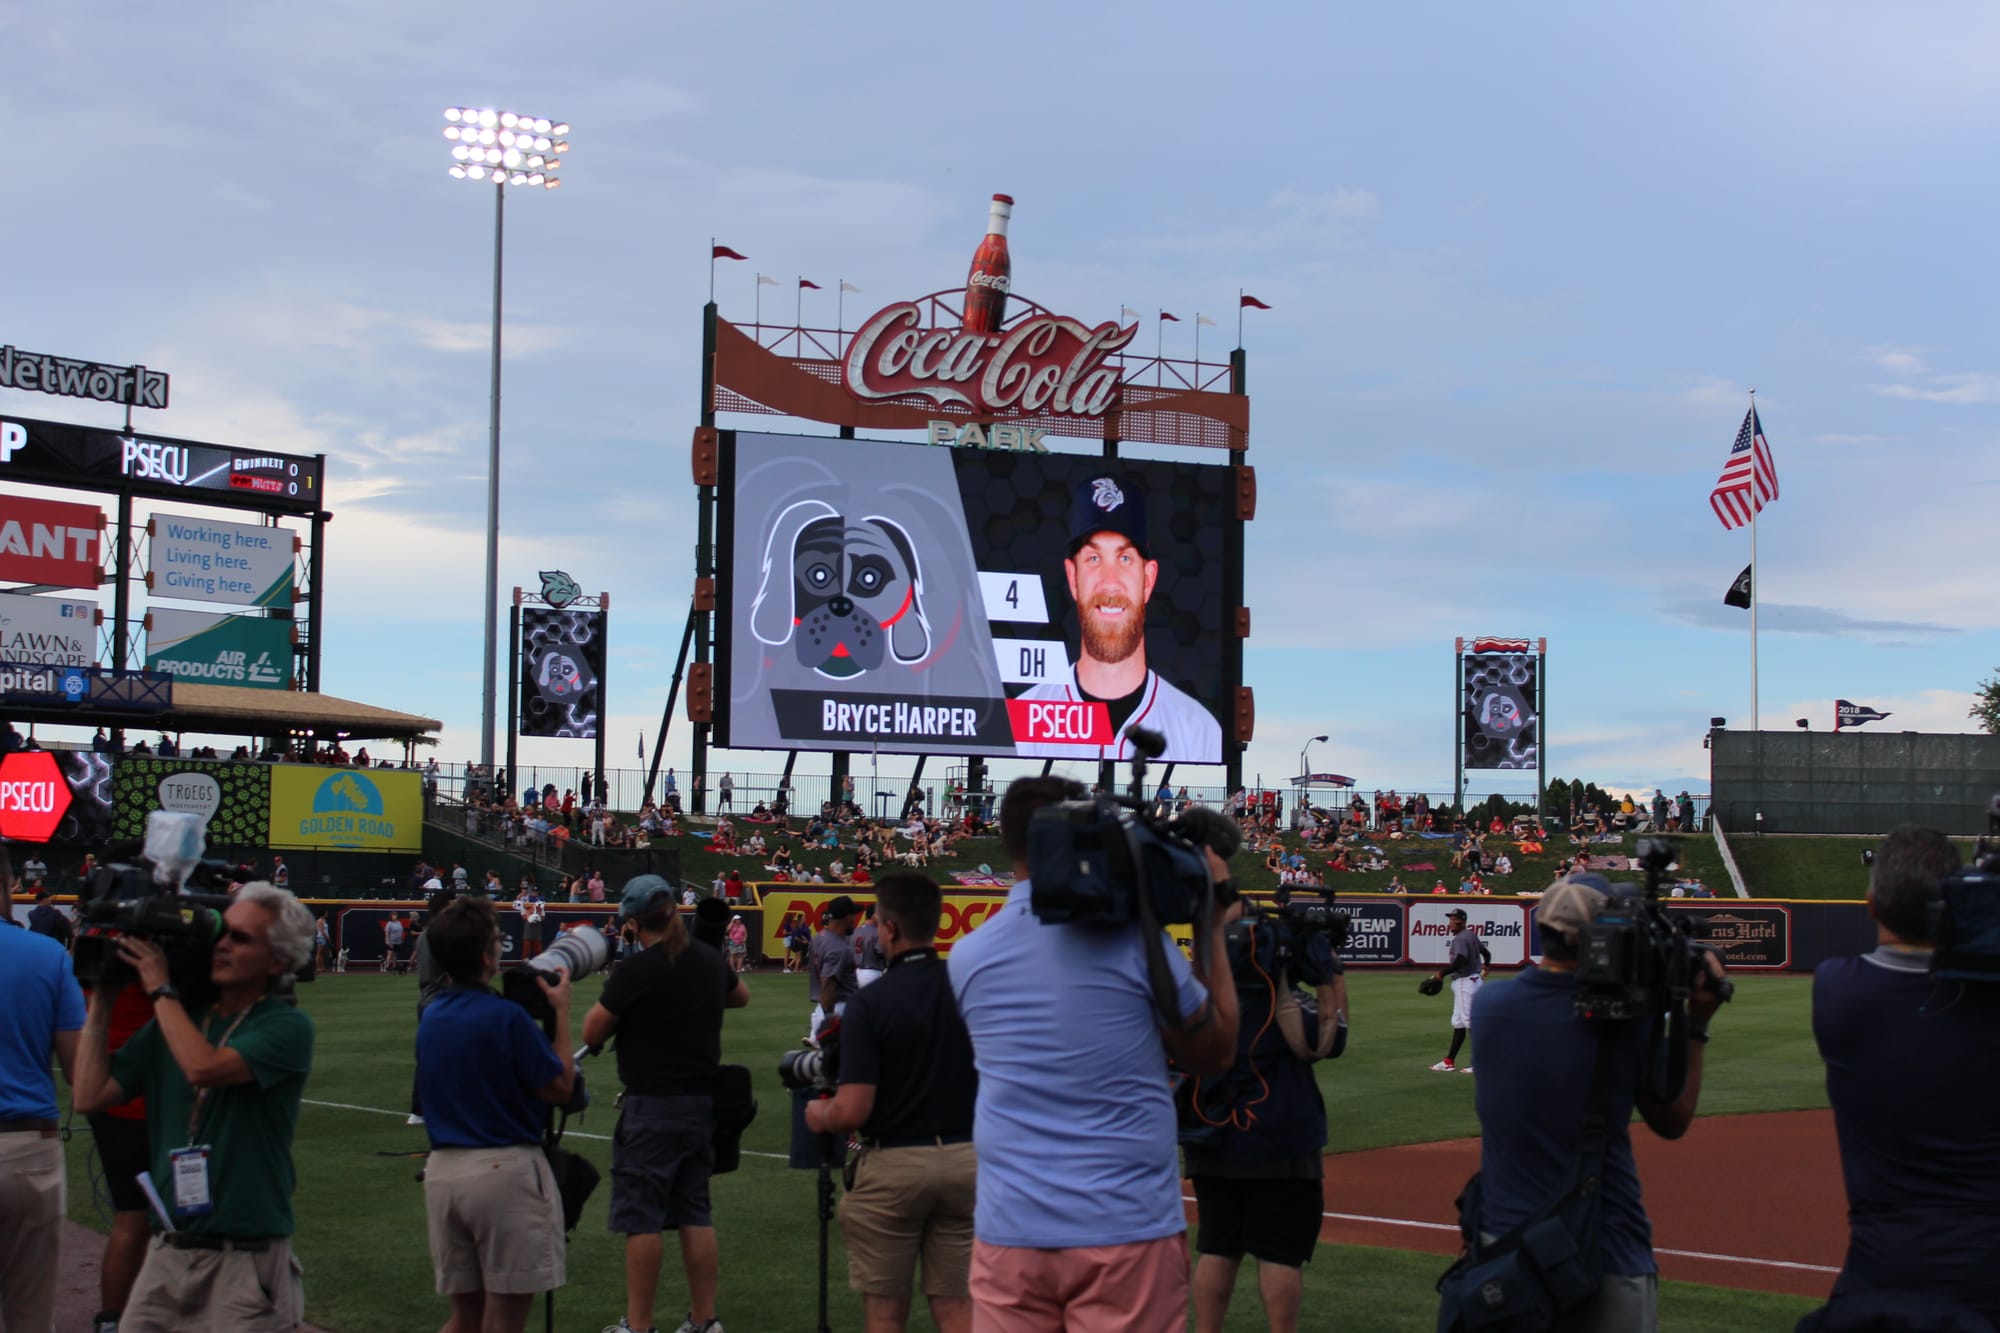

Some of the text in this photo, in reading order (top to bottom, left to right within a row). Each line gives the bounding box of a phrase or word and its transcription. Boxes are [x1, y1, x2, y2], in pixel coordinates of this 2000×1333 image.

[846, 304, 1140, 416] Coca-Cola
[928, 420, 1049, 453] PARK
[120, 437, 189, 483] PSECU
[289, 463, 299, 477] 0
[288, 482, 298, 495] 0
[306, 475, 312, 489] 1
[168, 524, 272, 549] Working here.
[166, 548, 252, 570] Living here.
[166, 571, 256, 594] Giving here.
[1005, 579, 1018, 609] 4
[156, 659, 245, 680] PRODUCTS
[216, 650, 246, 666] AIR
[1019, 647, 1046, 678] DH
[822, 699, 977, 737] BRYCE HARPER
[1027, 703, 1093, 740] PSECU
[1839, 706, 1860, 714] 2018
[0, 781, 55, 813] PSECU
[300, 816, 395, 839] GOLDEN ROAD
[1411, 919, 1522, 937] AmeranBank
[1735, 922, 1777, 940] Hotel
[1344, 934, 1389, 949] eam
